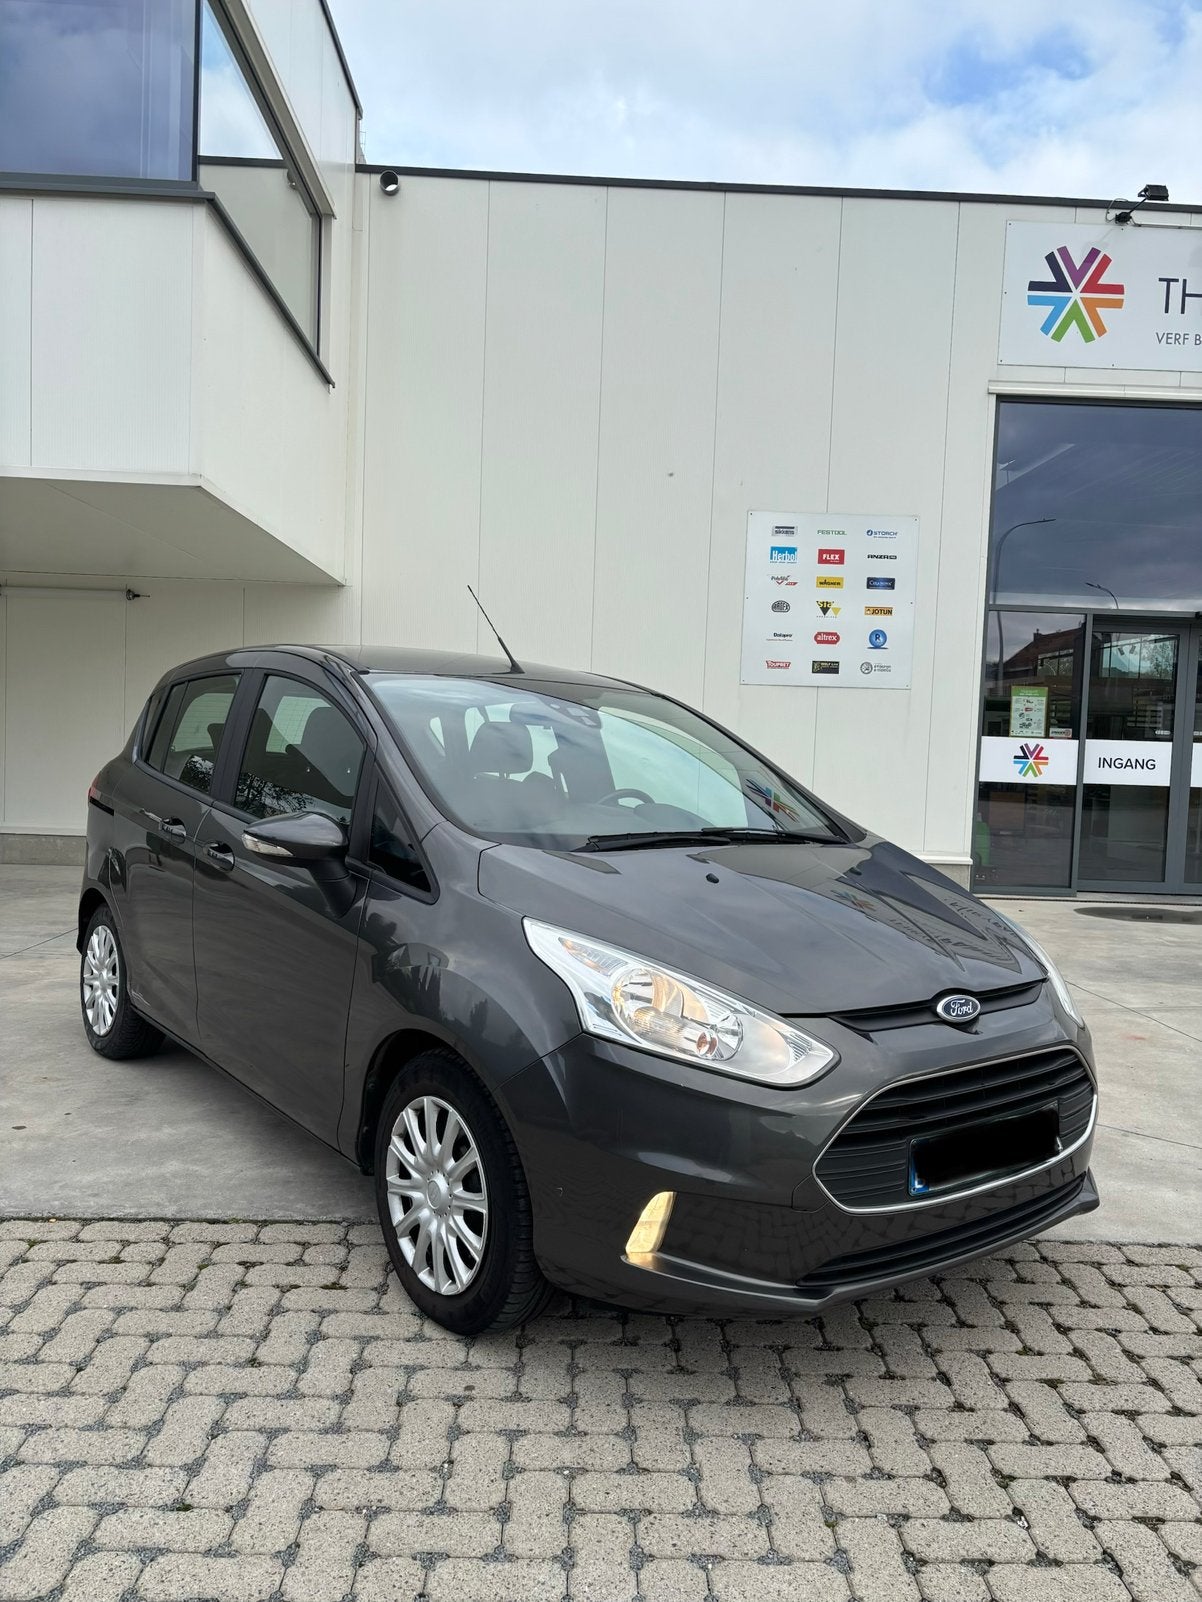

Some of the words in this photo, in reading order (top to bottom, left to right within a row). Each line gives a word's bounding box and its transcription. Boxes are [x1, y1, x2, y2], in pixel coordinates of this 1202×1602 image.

[1158, 277, 1202, 315] TH
[1155, 332, 1190, 345] VERF
[772, 549, 797, 561] Herbol
[817, 633, 838, 641] altrex
[1098, 757, 1156, 770] INGANG
[950, 998, 973, 1016] Ford
